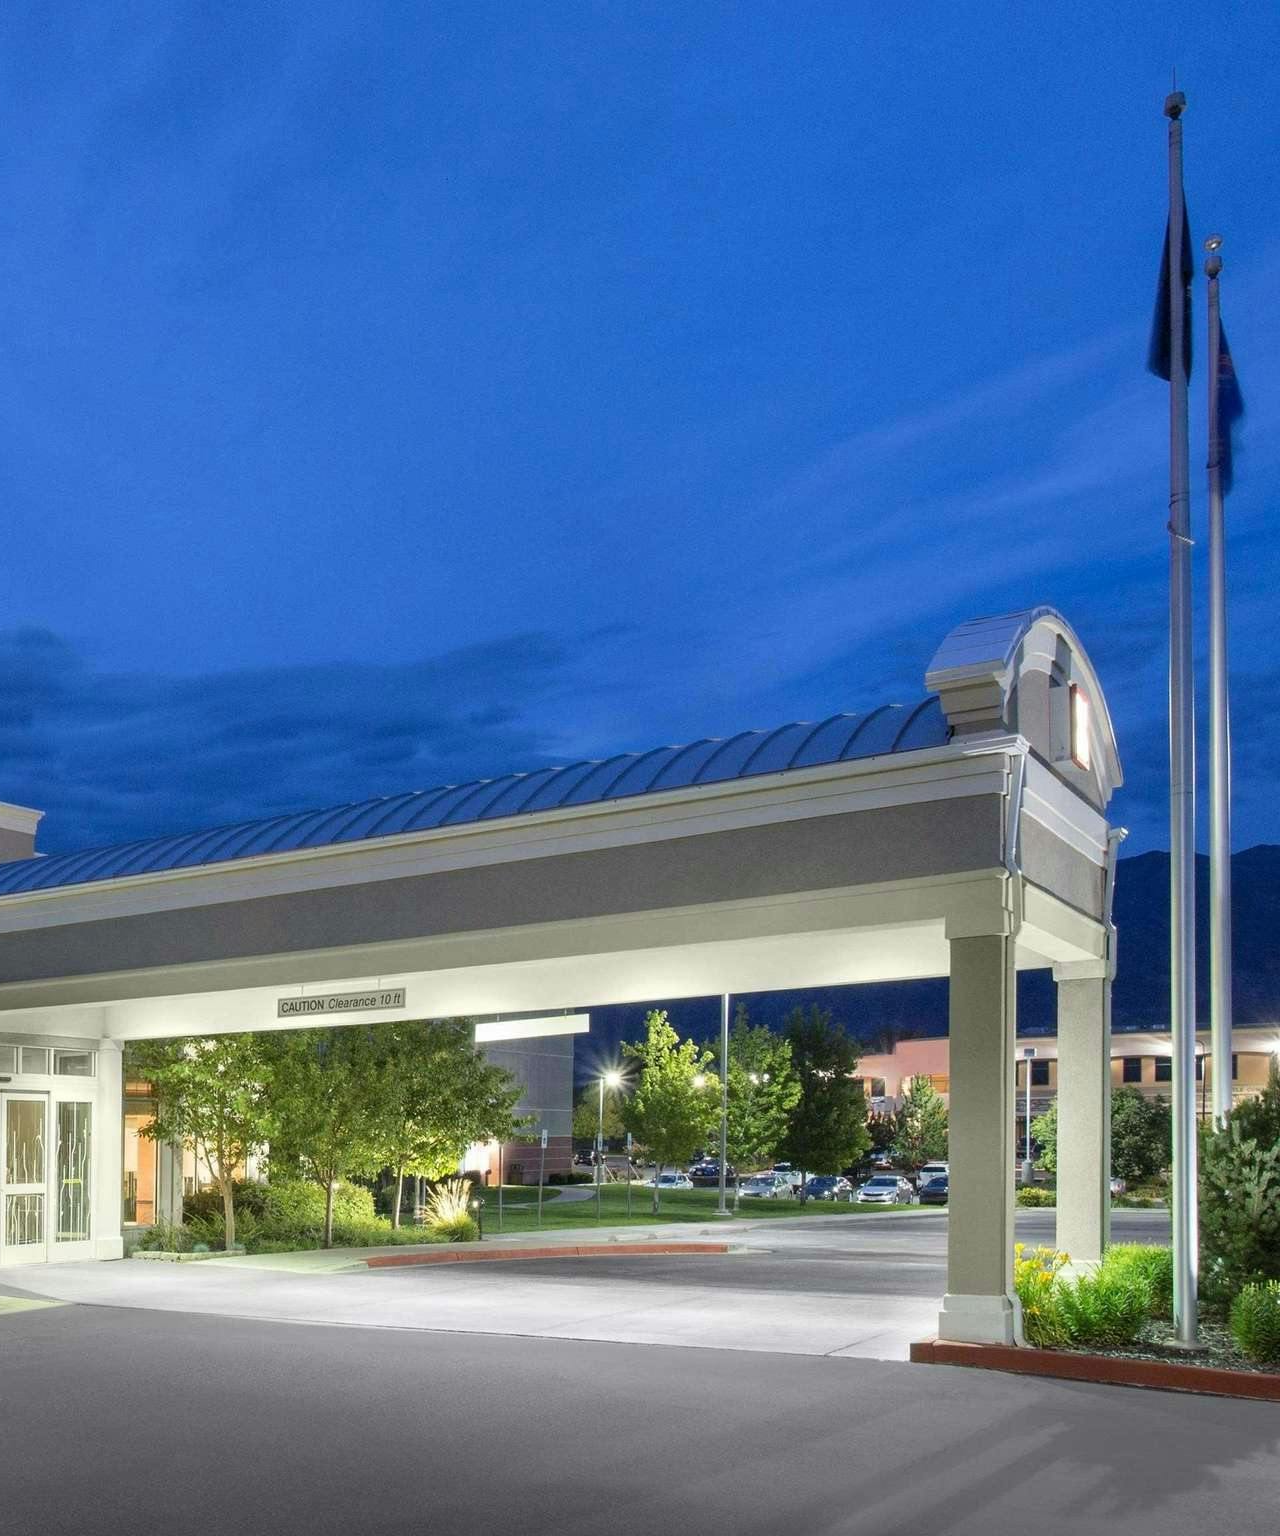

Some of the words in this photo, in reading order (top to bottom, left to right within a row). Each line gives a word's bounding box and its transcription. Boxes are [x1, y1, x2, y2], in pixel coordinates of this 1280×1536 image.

[281, 999, 325, 1013] CAUTION
[328, 996, 376, 1010] Clearance
[380, 994, 391, 1005] 10
[393, 993, 401, 1004] ft
